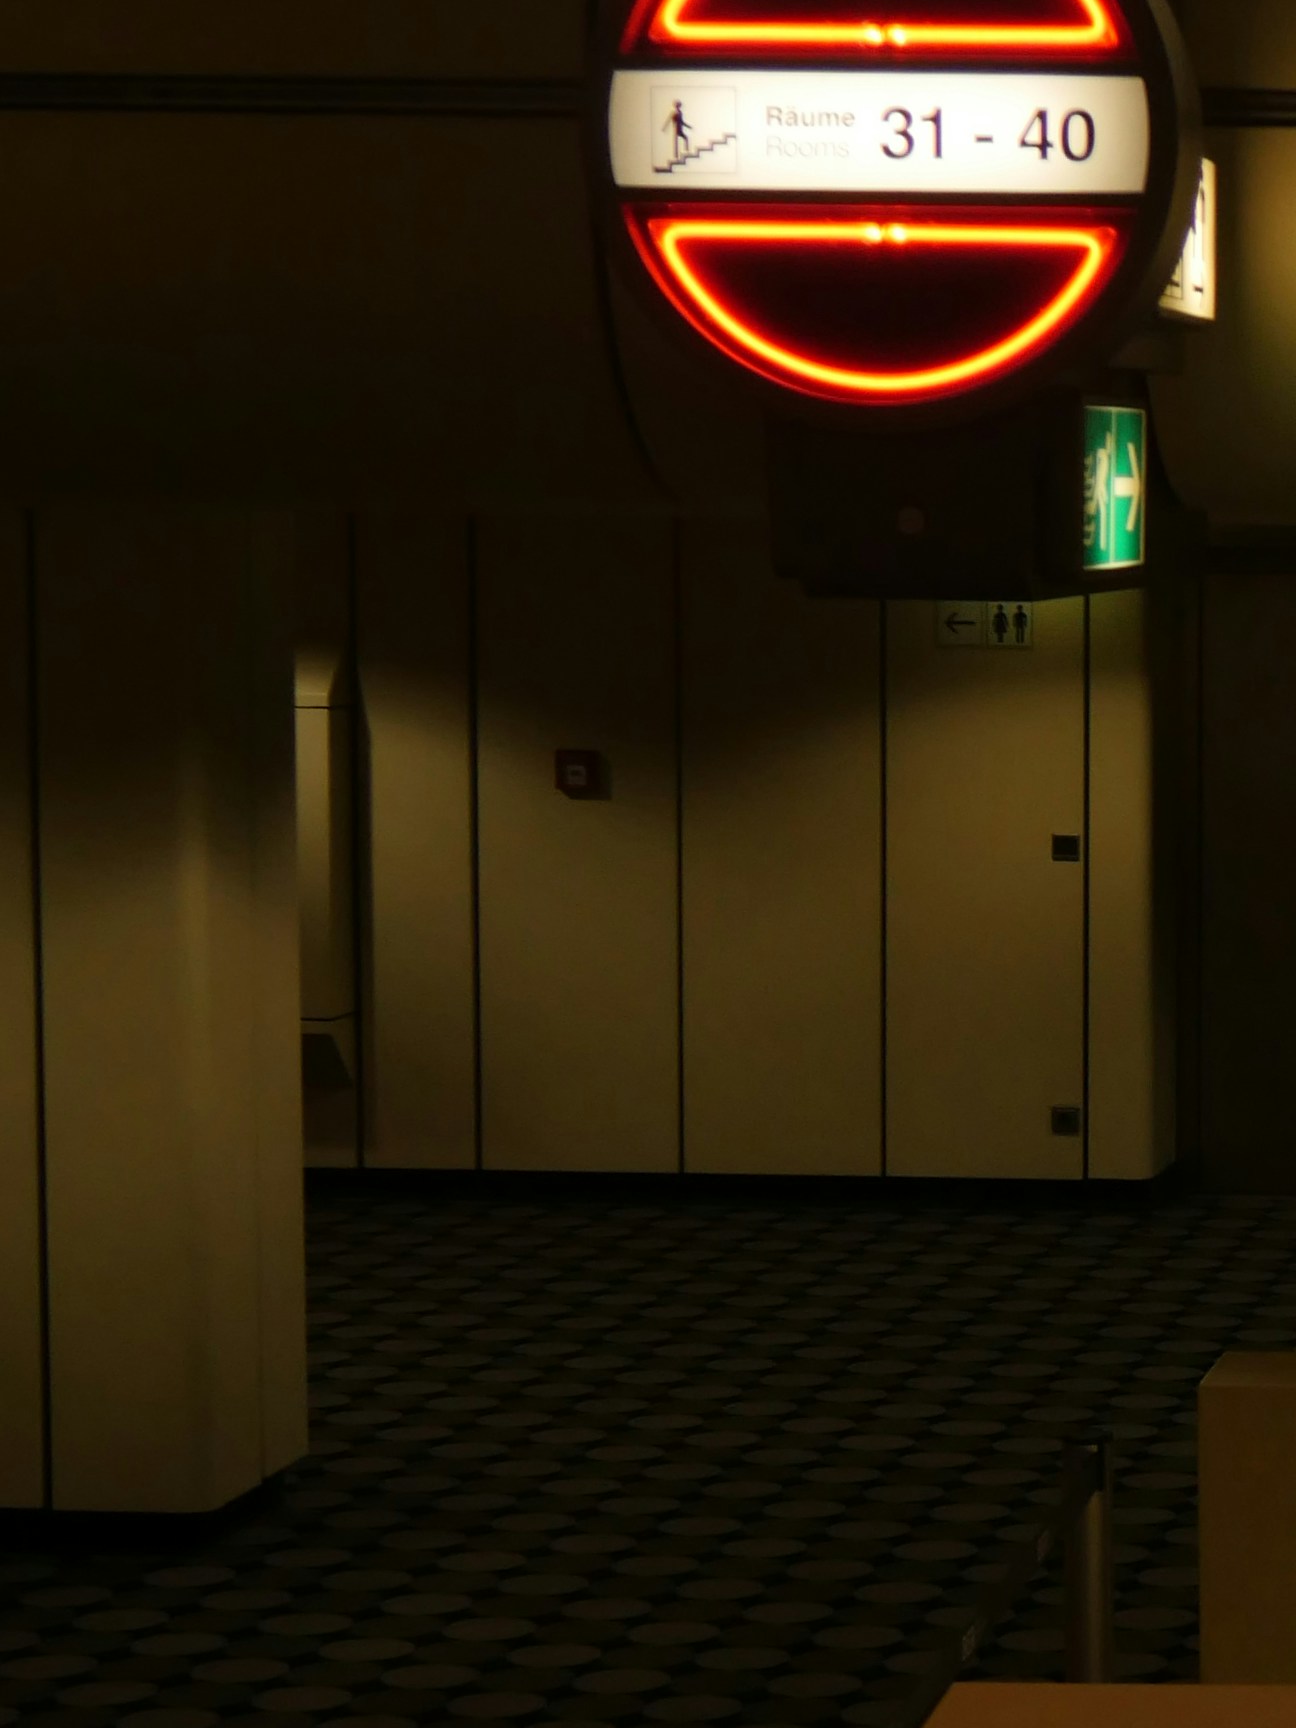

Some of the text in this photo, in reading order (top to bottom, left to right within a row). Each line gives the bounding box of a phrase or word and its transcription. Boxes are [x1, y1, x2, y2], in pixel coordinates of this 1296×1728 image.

[766, 105, 856, 128] Räume
[880, 105, 943, 160] 31
[1019, 107, 1096, 162] 40
[766, 135, 850, 159] Rooms
